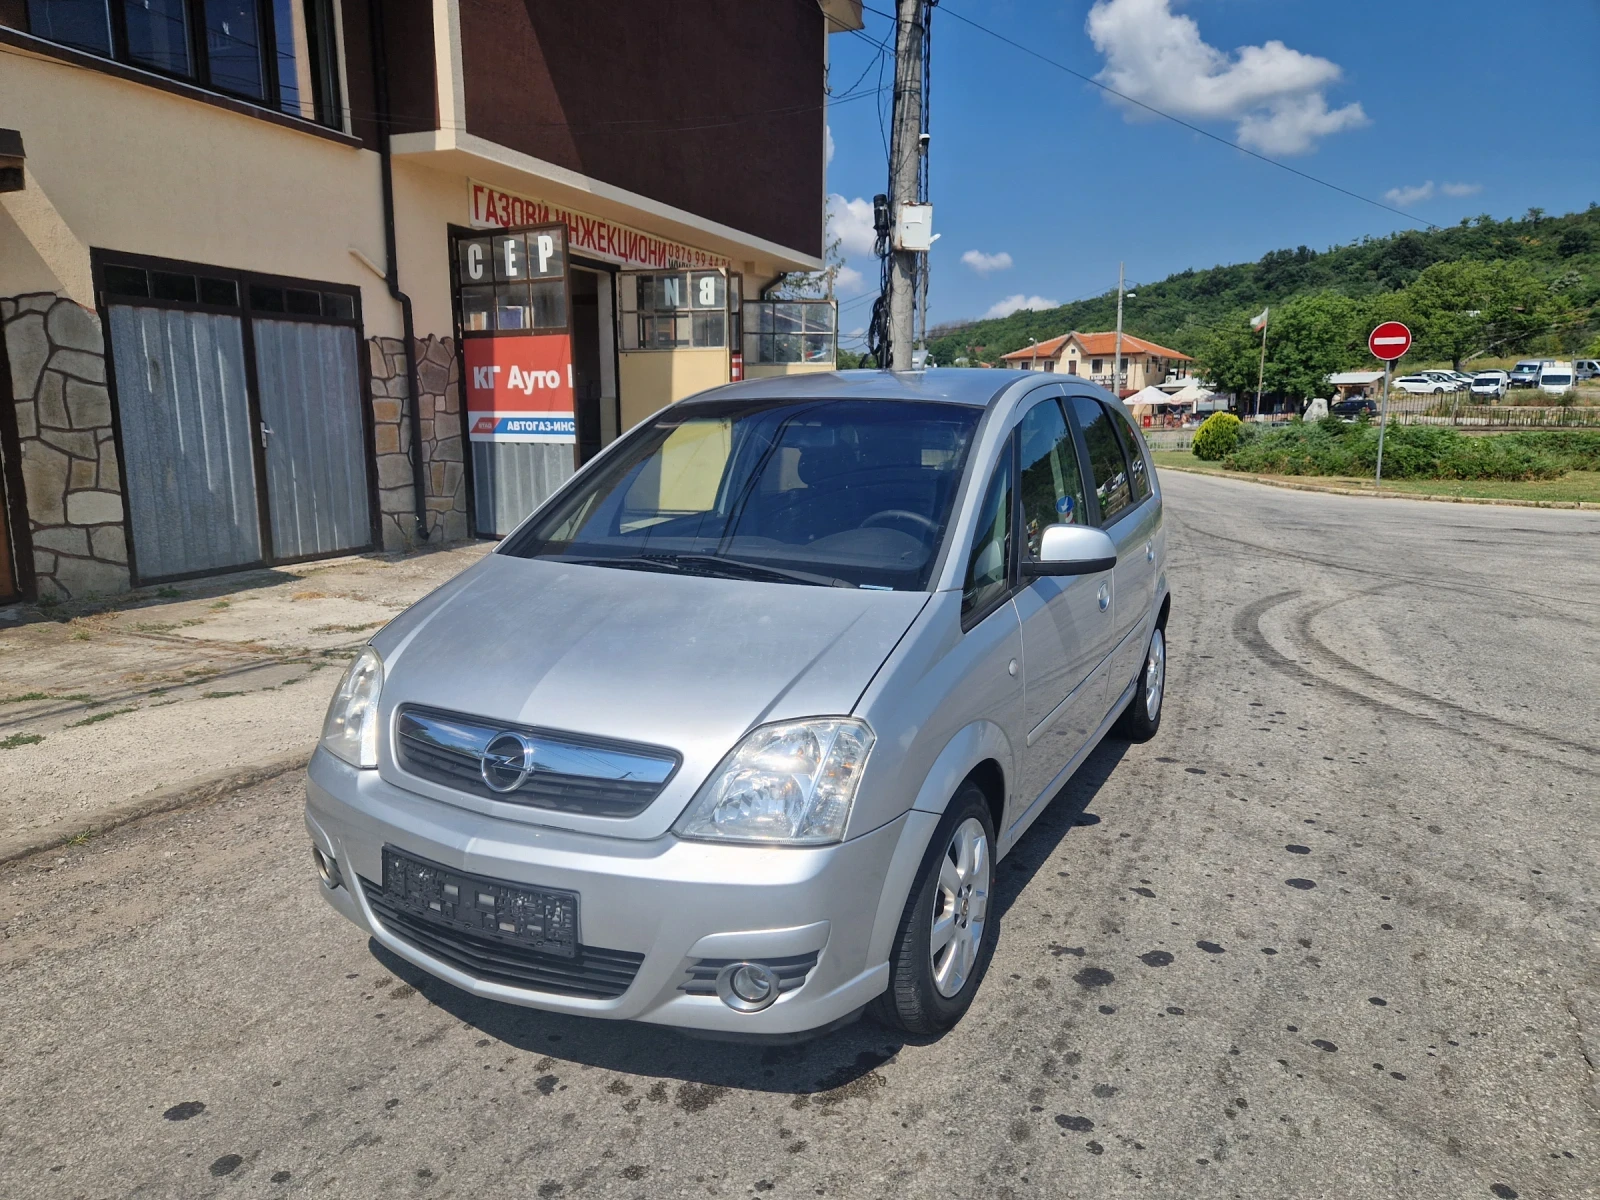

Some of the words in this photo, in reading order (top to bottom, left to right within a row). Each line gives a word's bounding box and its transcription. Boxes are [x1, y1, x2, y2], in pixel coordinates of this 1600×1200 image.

[473, 185, 550, 227] ГАЗОВИ
[669, 243, 692, 263] 0876
[695, 251, 706, 267] 99
[473, 365, 501, 389] КГ
[507, 365, 560, 395] Ауто
[507, 421, 575, 432] АВТОГАЗ-ИНС
